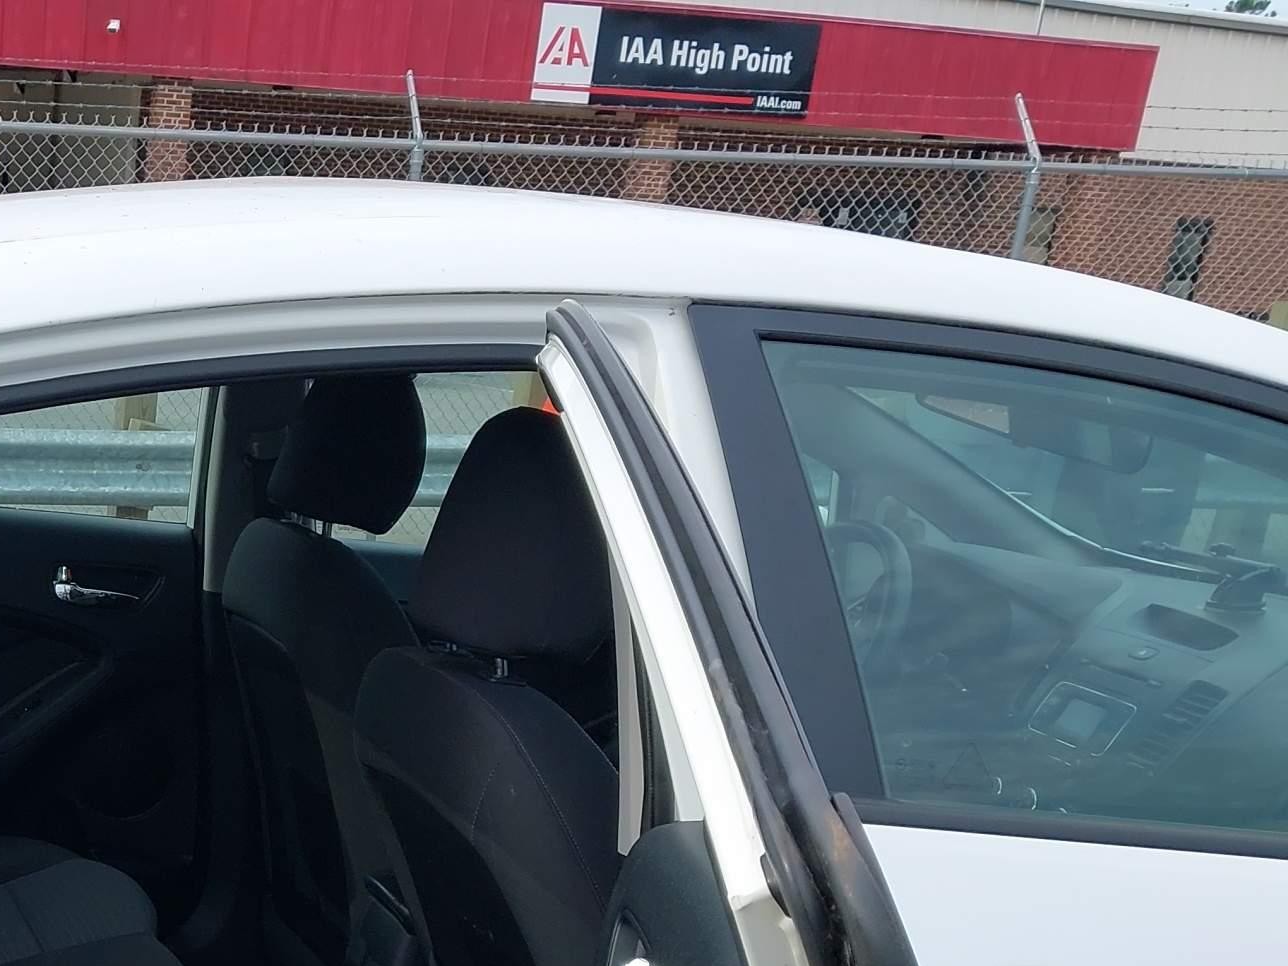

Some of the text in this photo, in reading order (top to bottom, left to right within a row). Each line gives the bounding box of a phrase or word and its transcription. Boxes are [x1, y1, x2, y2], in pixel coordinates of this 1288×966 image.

[619, 35, 794, 76] IAA High Point
[756, 95, 803, 111] IAAI.com
